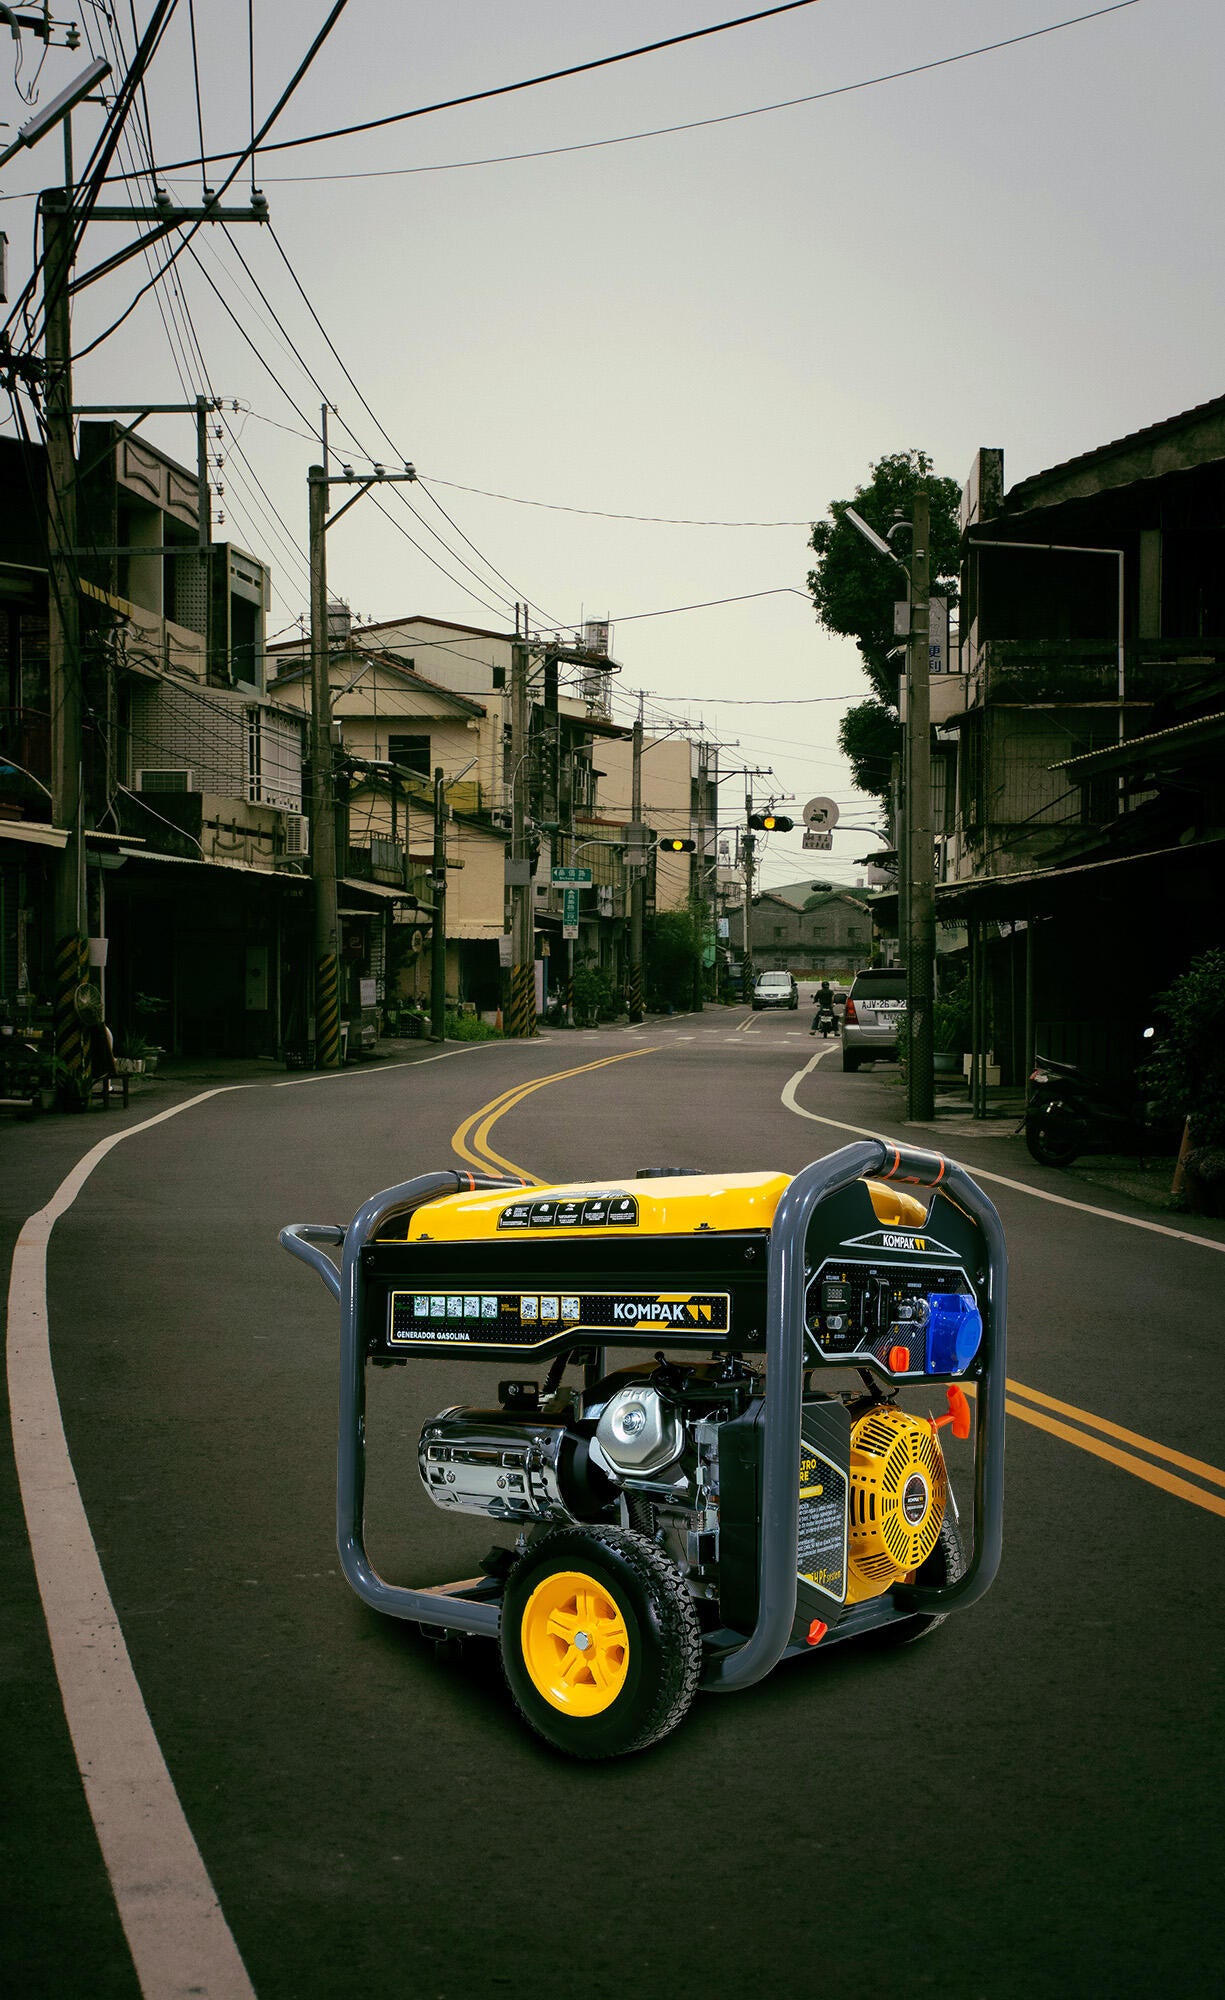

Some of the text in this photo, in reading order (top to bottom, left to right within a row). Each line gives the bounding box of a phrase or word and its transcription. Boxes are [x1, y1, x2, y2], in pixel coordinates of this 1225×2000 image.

[882, 1234, 915, 1250] KOMPAK
[613, 1303, 685, 1321] KOMPAK
[396, 1330, 471, 1341] GENERADOR GASOLINA
